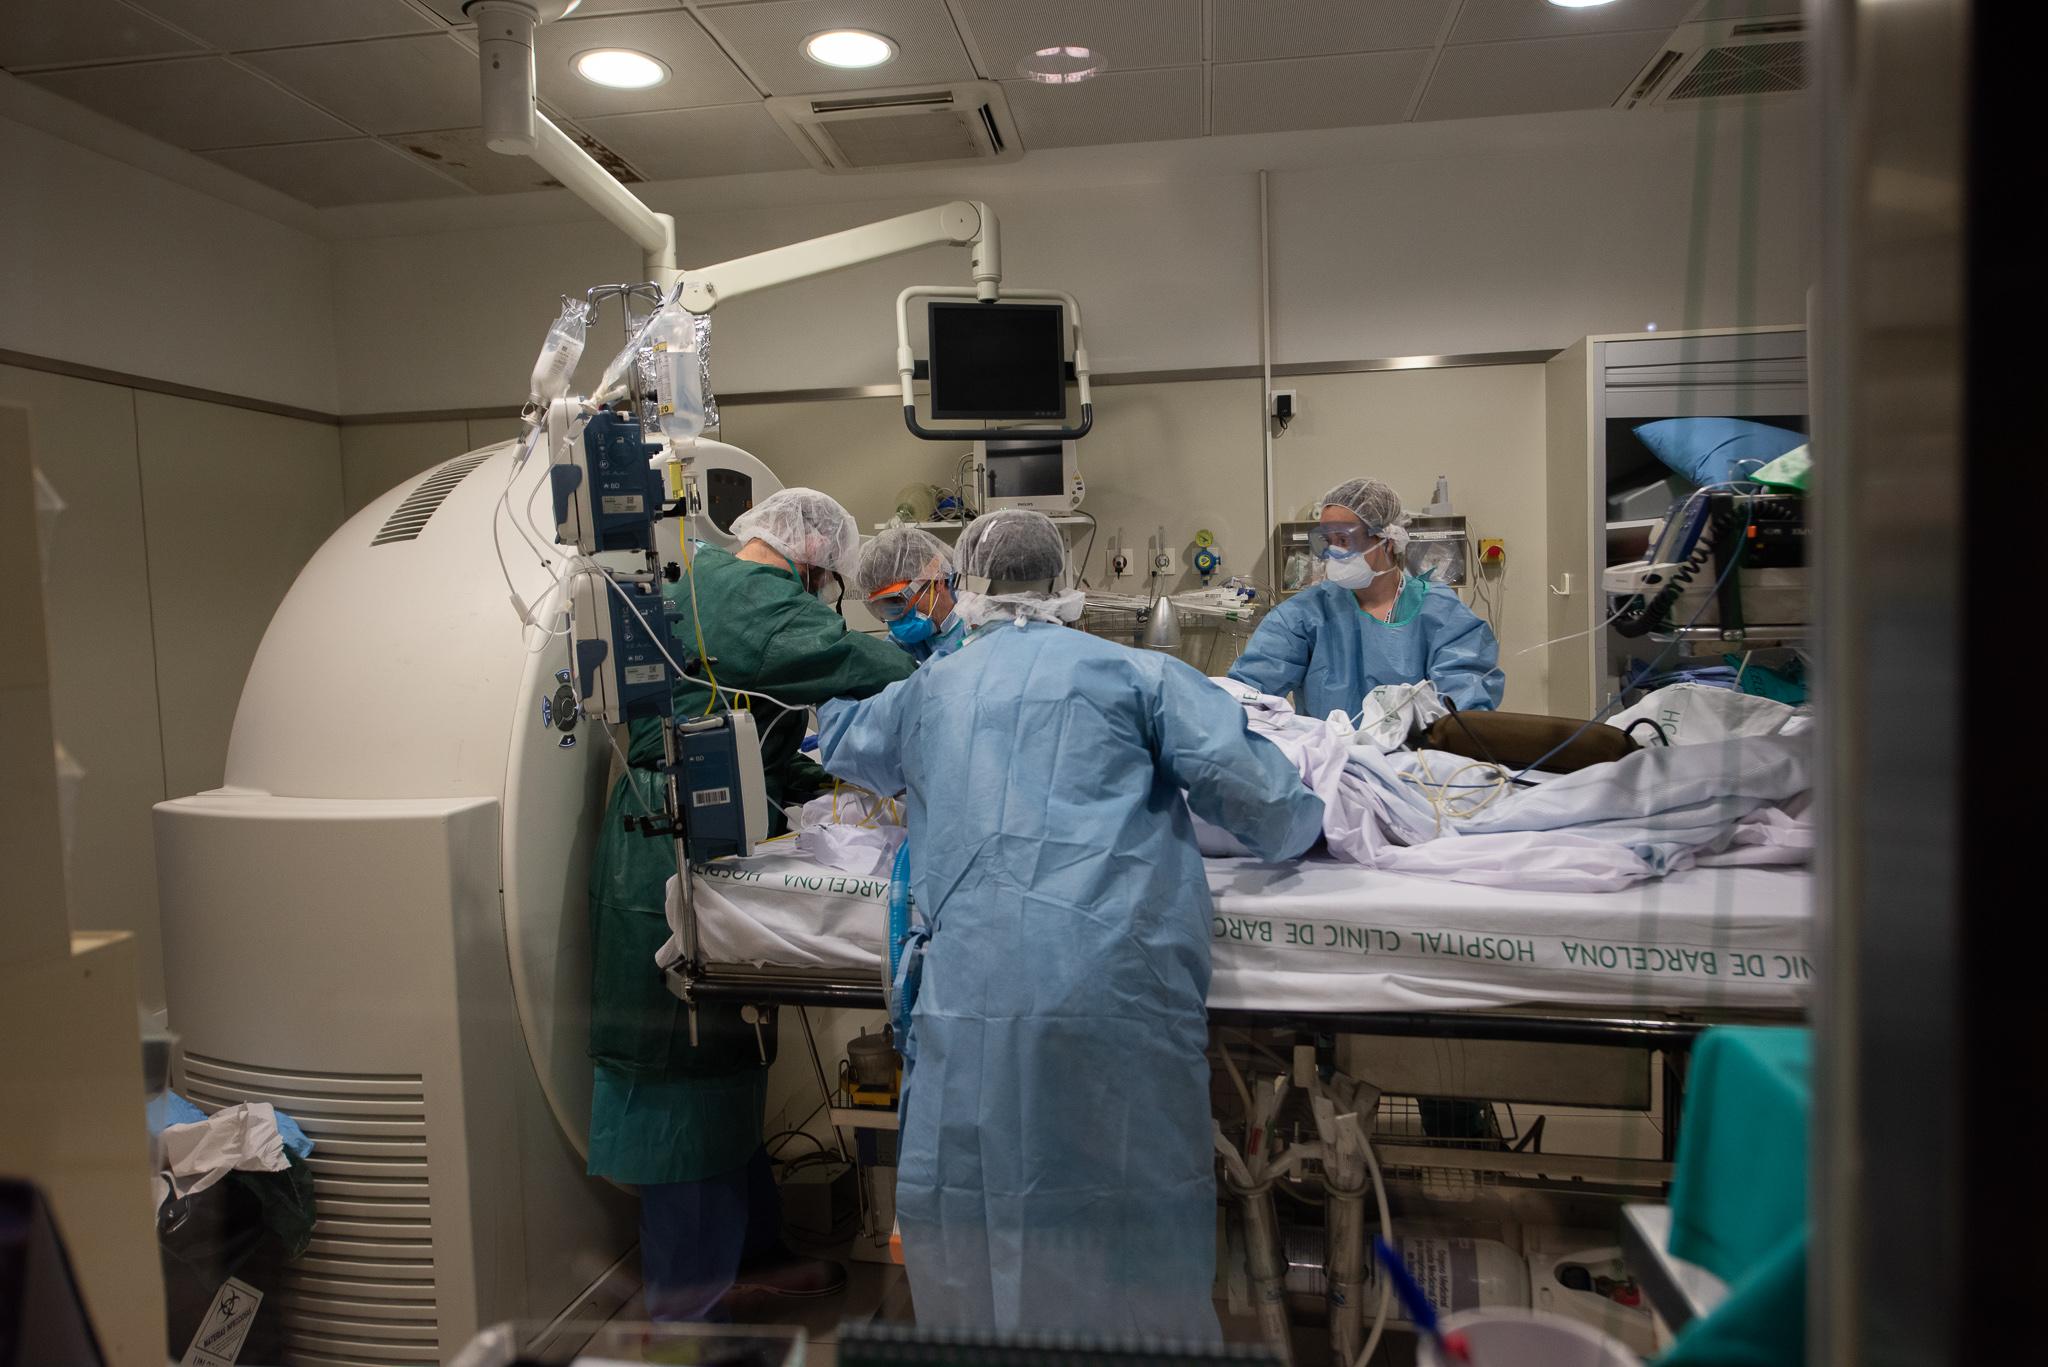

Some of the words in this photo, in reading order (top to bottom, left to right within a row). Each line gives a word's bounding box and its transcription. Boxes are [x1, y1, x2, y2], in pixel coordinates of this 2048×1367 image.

[784, 874, 889, 899] ARCELONA
[1214, 917, 1273, 942] BARC
[1285, 922, 1314, 945] DE
[1323, 924, 1401, 955] CLÍNIC
[1412, 931, 1536, 962] HOSPITAL
[1561, 940, 1718, 975] BARCELONA
[1729, 953, 1766, 977] DE
